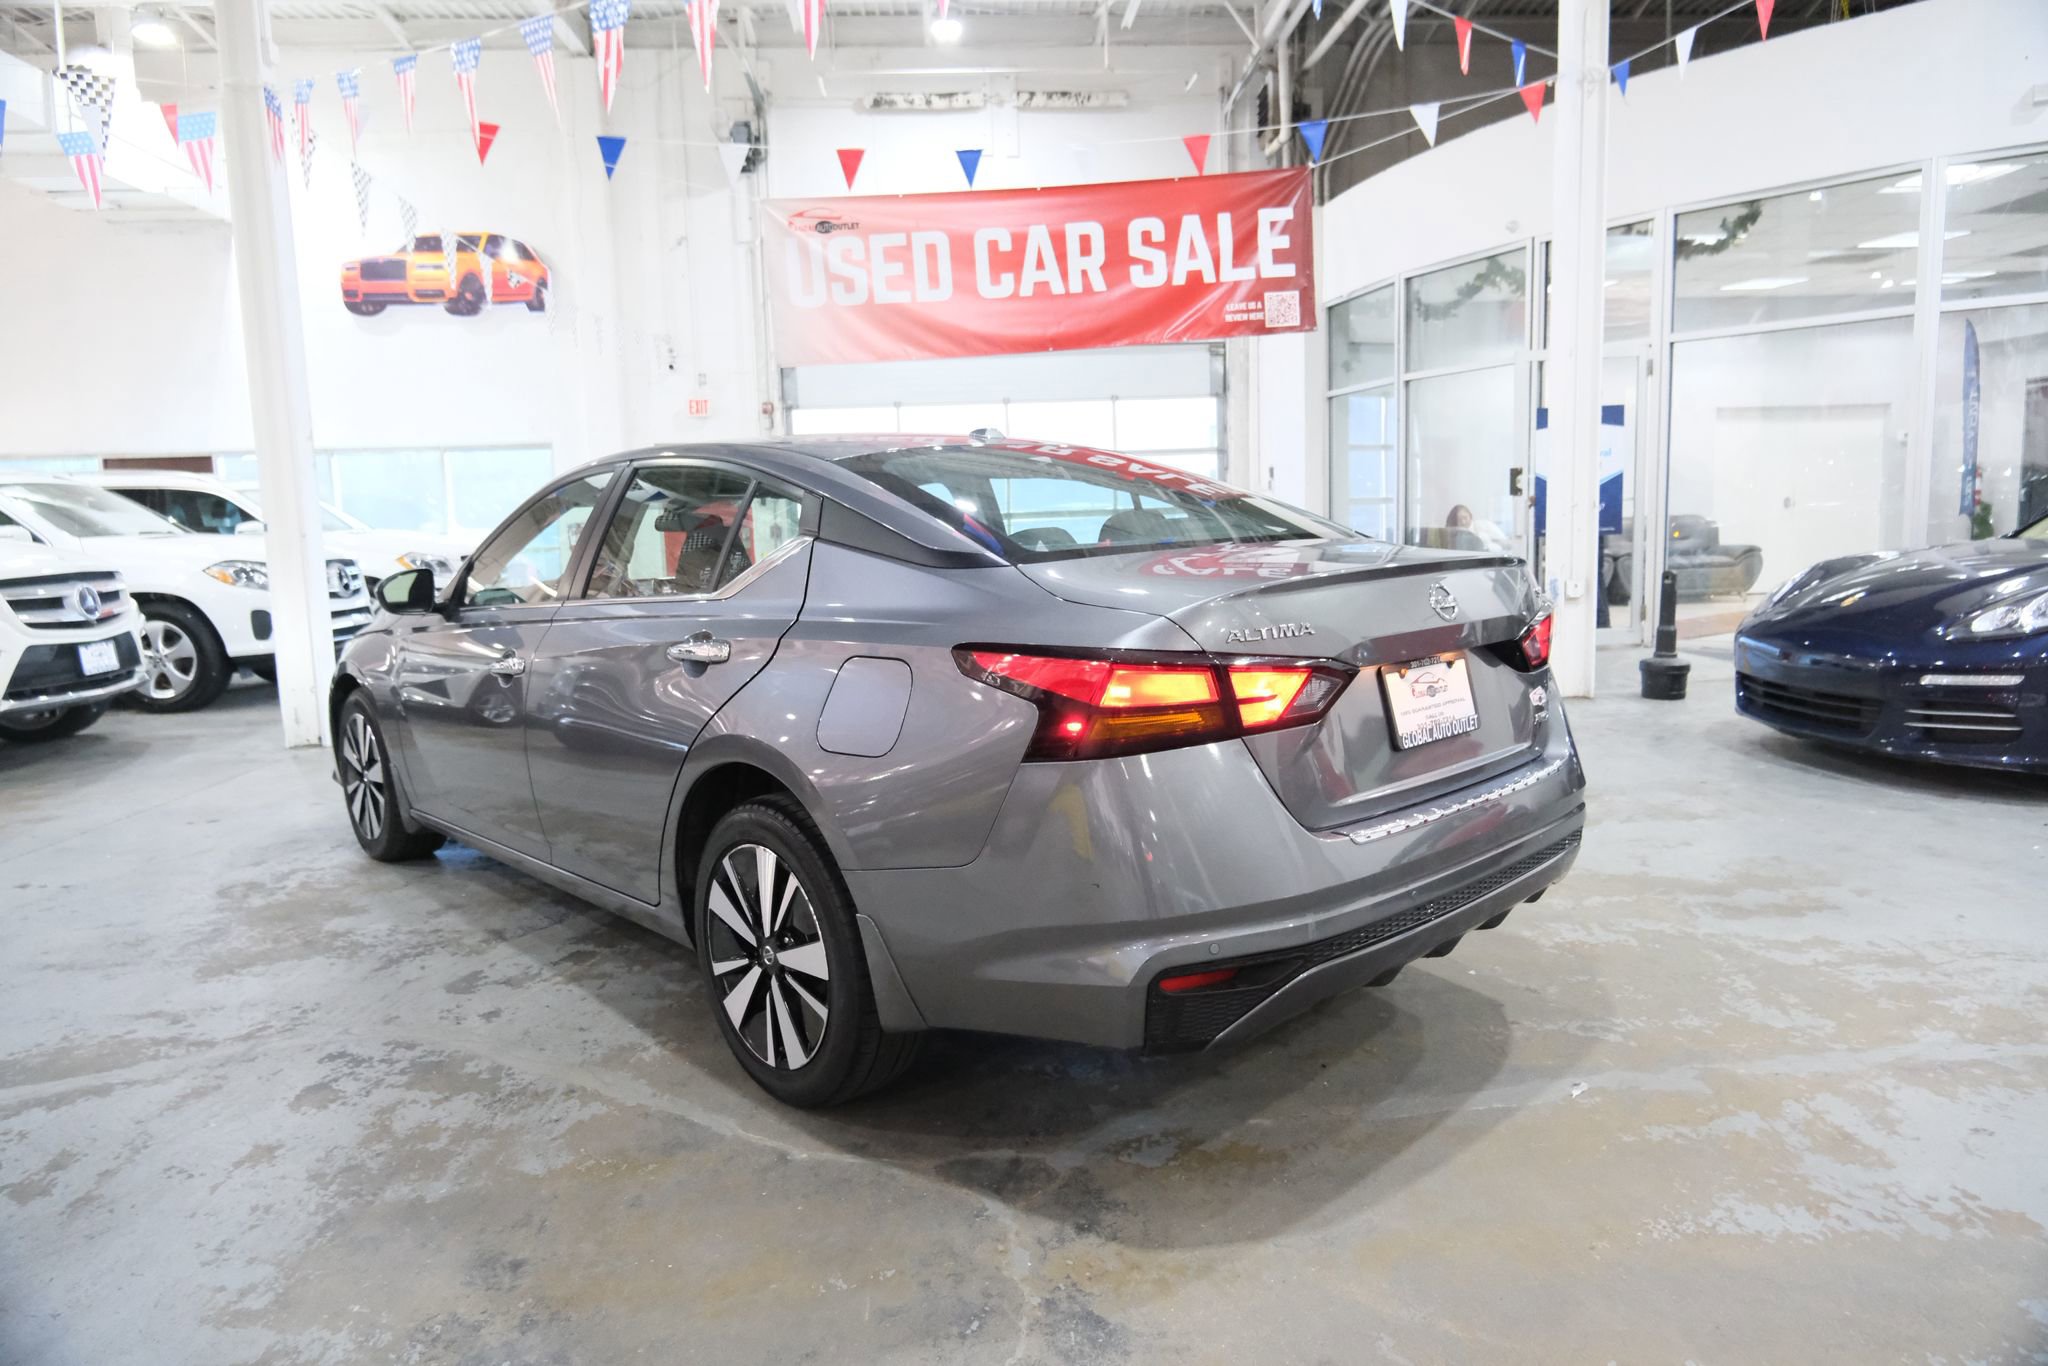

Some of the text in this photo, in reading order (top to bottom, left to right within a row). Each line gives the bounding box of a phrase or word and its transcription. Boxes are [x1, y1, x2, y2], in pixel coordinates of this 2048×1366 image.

[786, 206, 1296, 309] USED CAR SALE
[689, 399, 709, 415] EXIT
[1226, 621, 1316, 643] ALTIMA
[1402, 714, 1478, 749] GLOBAL AUTO OUTLET
